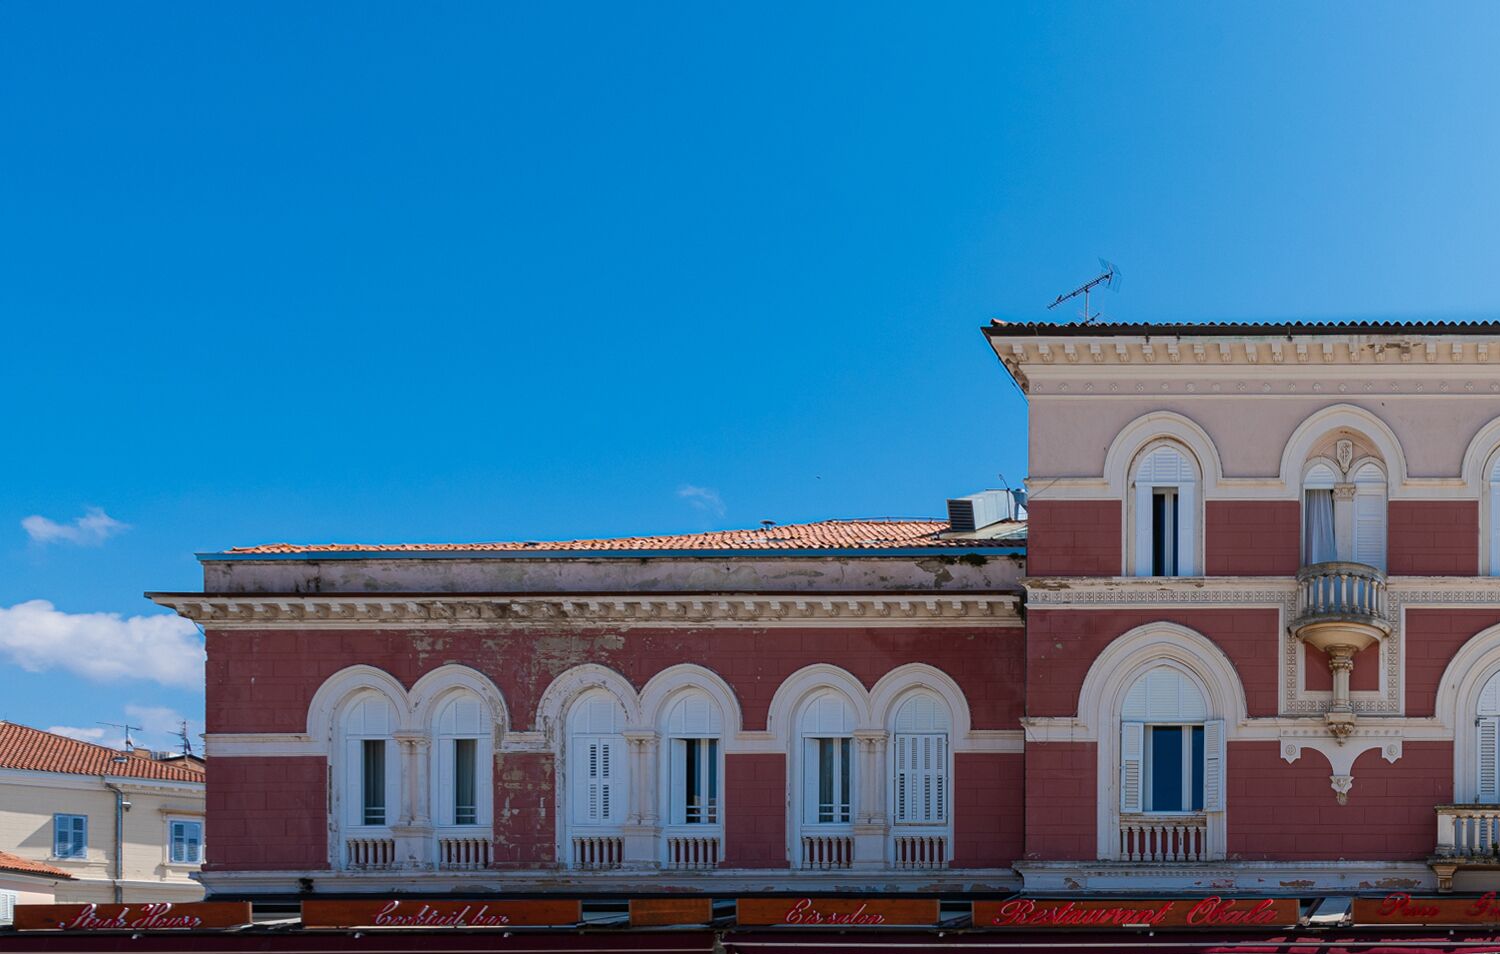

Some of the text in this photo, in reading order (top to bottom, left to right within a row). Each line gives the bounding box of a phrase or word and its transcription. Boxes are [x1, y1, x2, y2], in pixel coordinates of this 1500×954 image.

[130, 902, 204, 929] House
[374, 900, 510, 926] Cocktail bar
[991, 896, 1278, 926] Restaurant Obala
